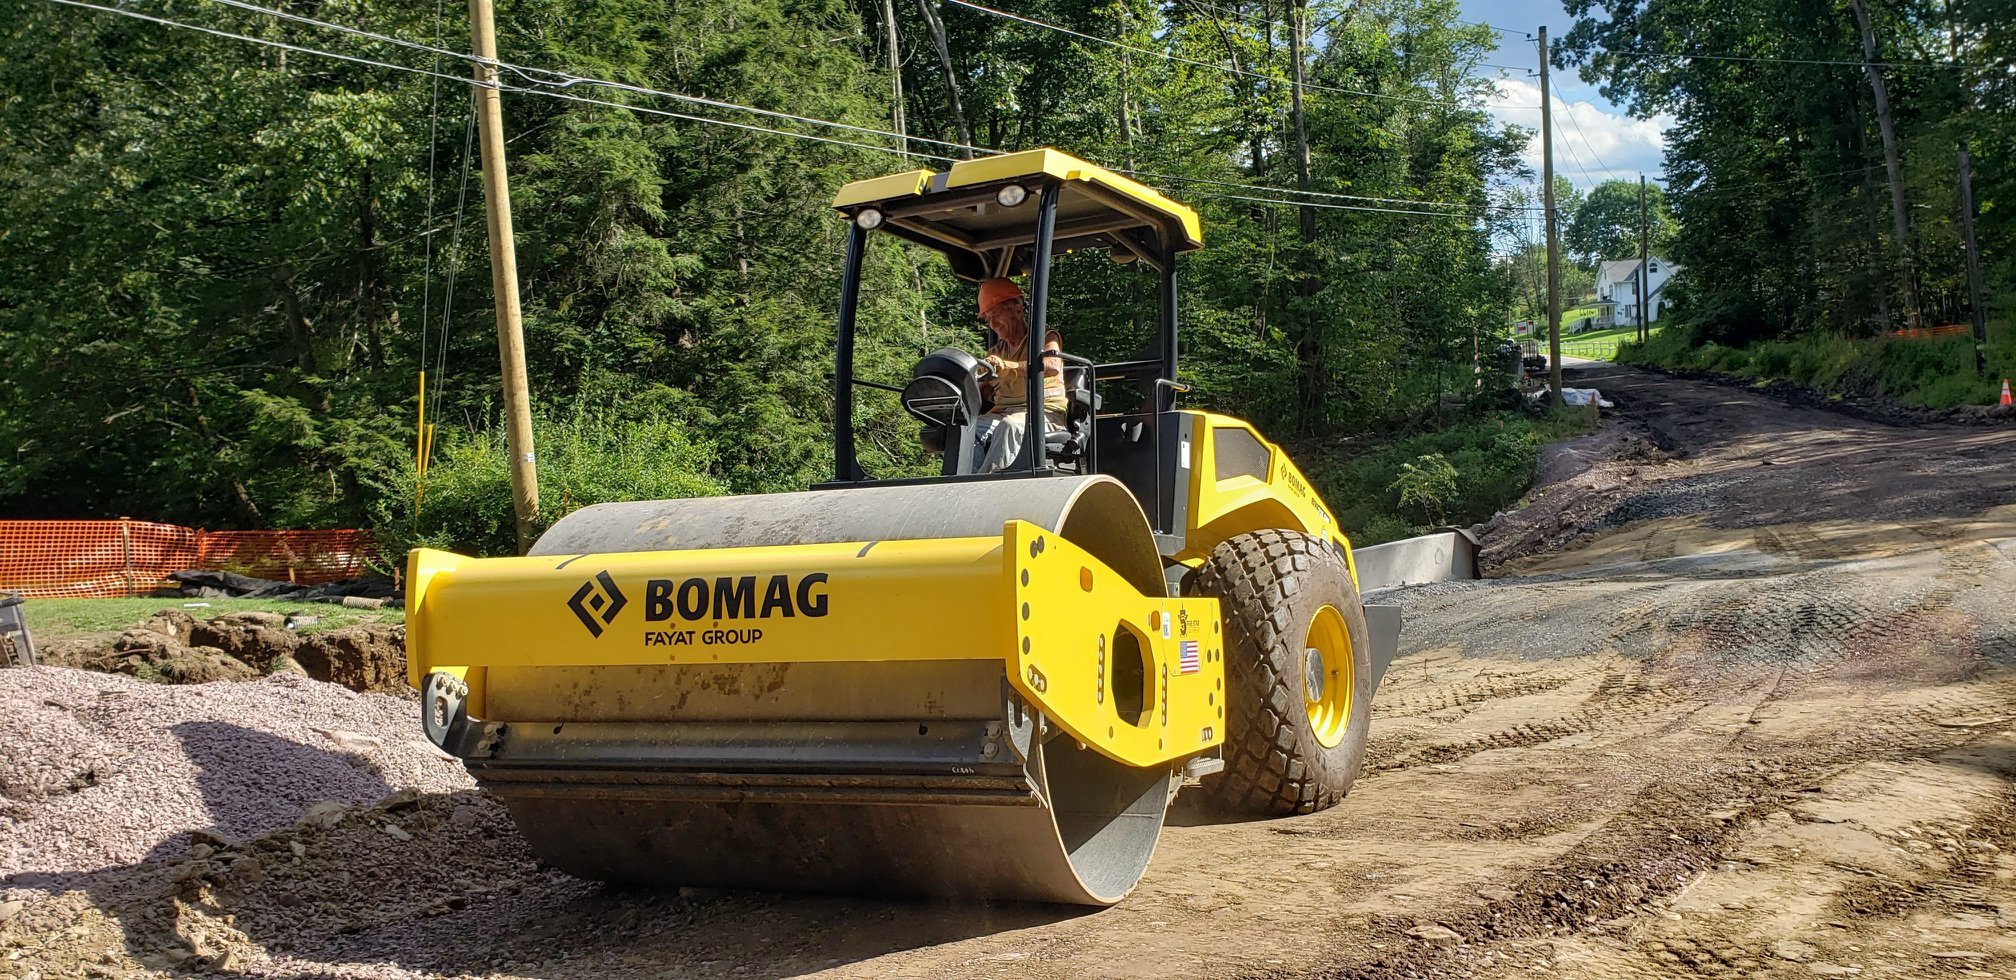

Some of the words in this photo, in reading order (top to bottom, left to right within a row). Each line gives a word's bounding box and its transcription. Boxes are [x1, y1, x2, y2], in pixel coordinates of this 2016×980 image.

[1288, 472, 1306, 498] BOMAG
[645, 573, 829, 622] BOMAG
[645, 630, 696, 646] FAYAT
[702, 629, 763, 645] GROUP
